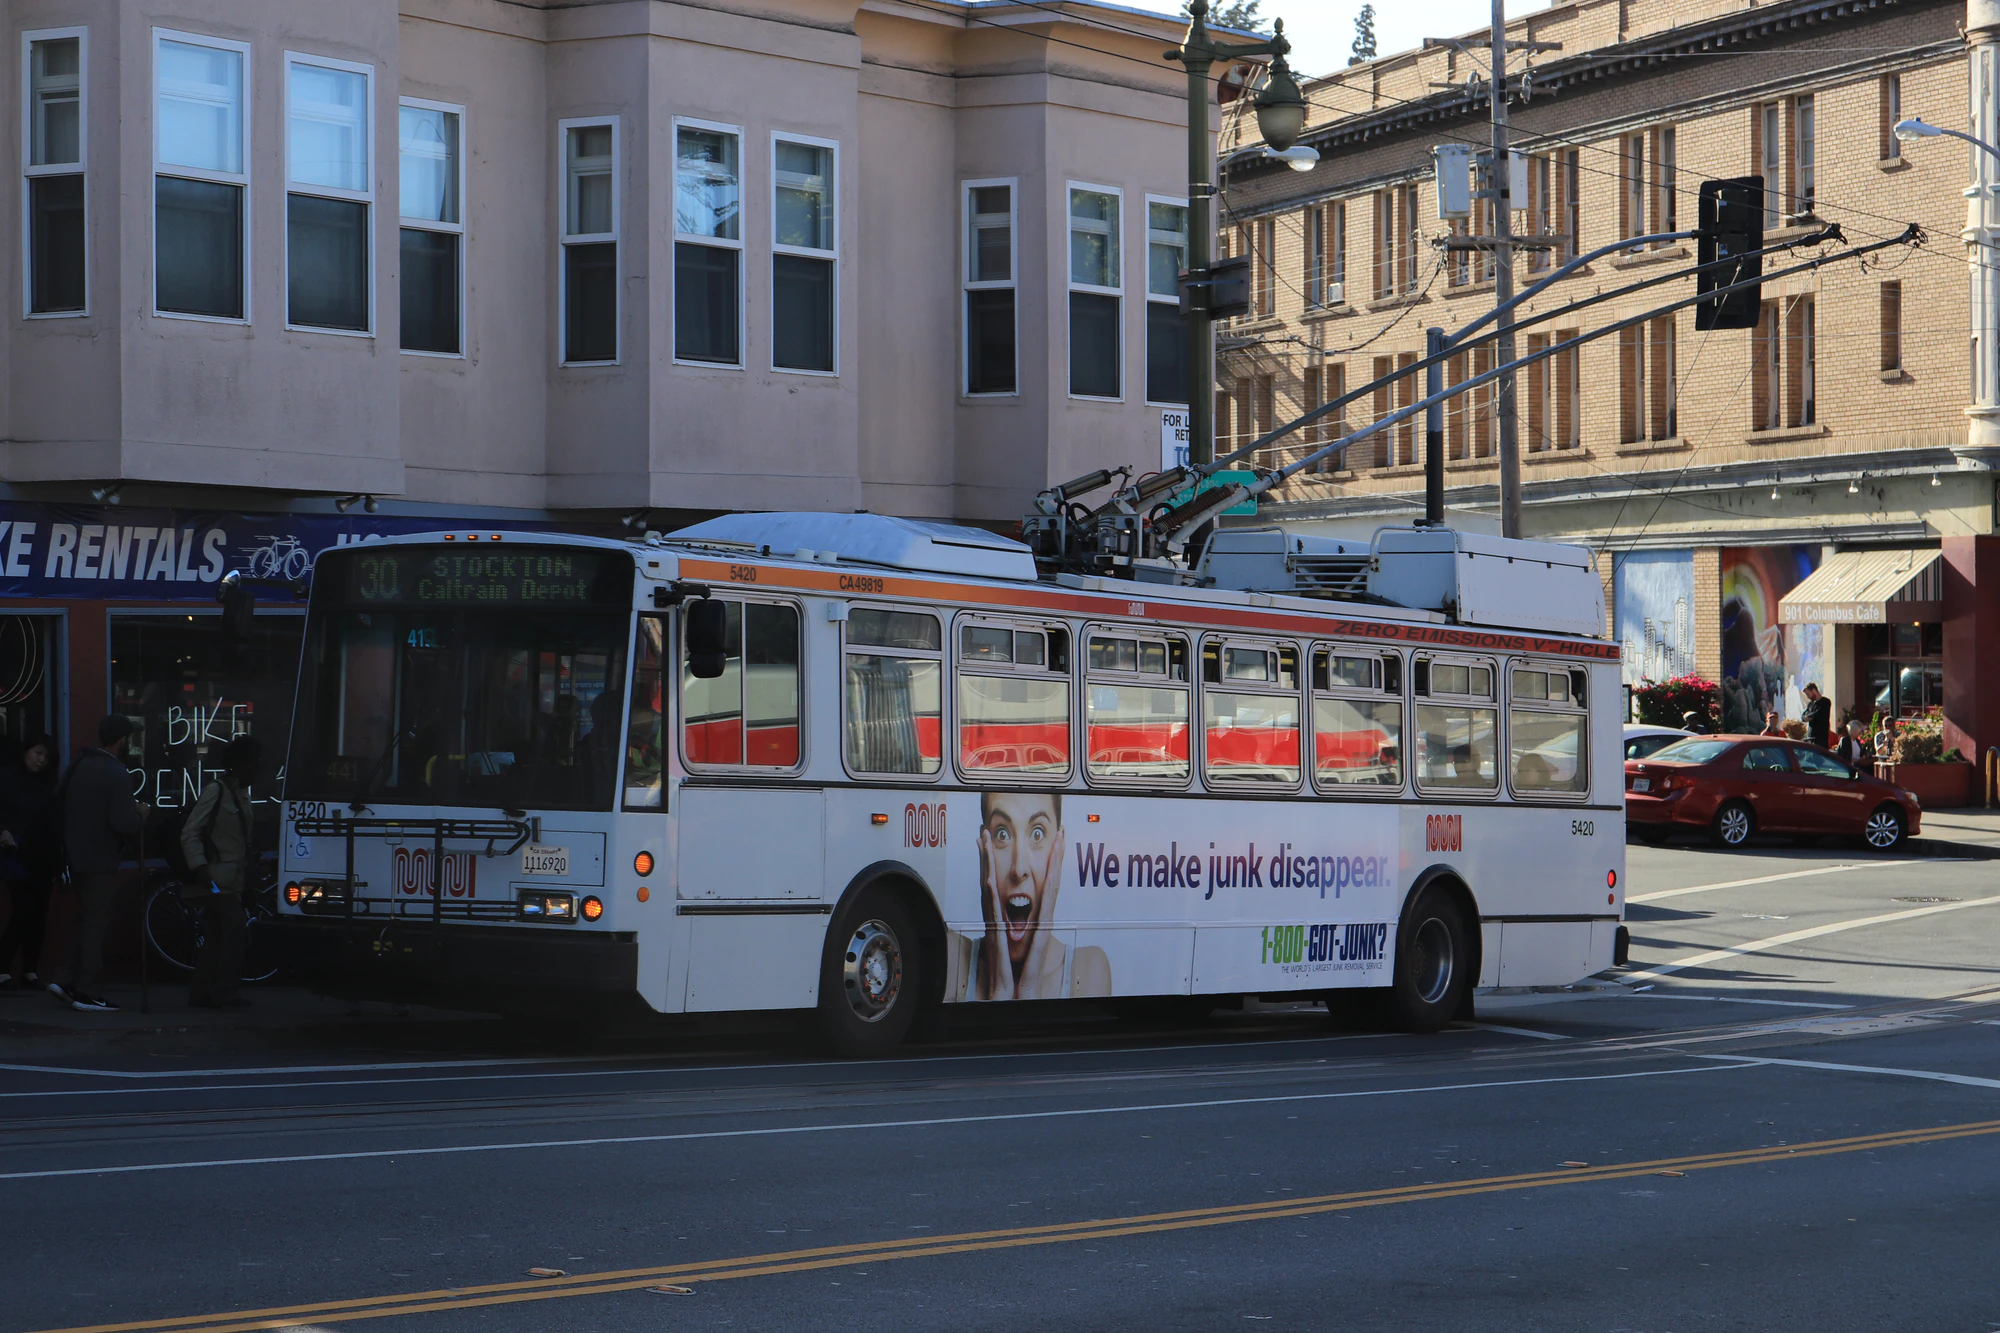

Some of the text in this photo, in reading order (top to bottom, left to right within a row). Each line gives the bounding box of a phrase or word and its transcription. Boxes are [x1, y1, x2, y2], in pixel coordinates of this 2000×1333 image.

[1164, 414, 1181, 427] FOR
[1175, 428, 1190, 441] RET
[44, 523, 227, 583] RENTALS
[360, 556, 572, 600] 30 STOCKTON
[730, 565, 757, 582] 5420
[419, 579, 587, 601] Caltrain Depot
[839, 575, 884, 593] CA49819
[1785, 604, 1880, 621] 901 Columbus Cafe
[1333, 620, 1399, 638] ZERO
[1407, 628, 1525, 650] EMISSIONS
[168, 697, 247, 745] BIKE
[288, 801, 326, 820] 5420
[1571, 820, 1594, 836] 5420
[524, 856, 566, 871] 1116920
[1076, 841, 1391, 901] We make junk disappear.
[1261, 922, 1387, 964] 1-800-GOT-JUNK?
[1281, 962, 1383, 974] THE WORLD'S LARGEST JUNK REMOVAL SERVICE
